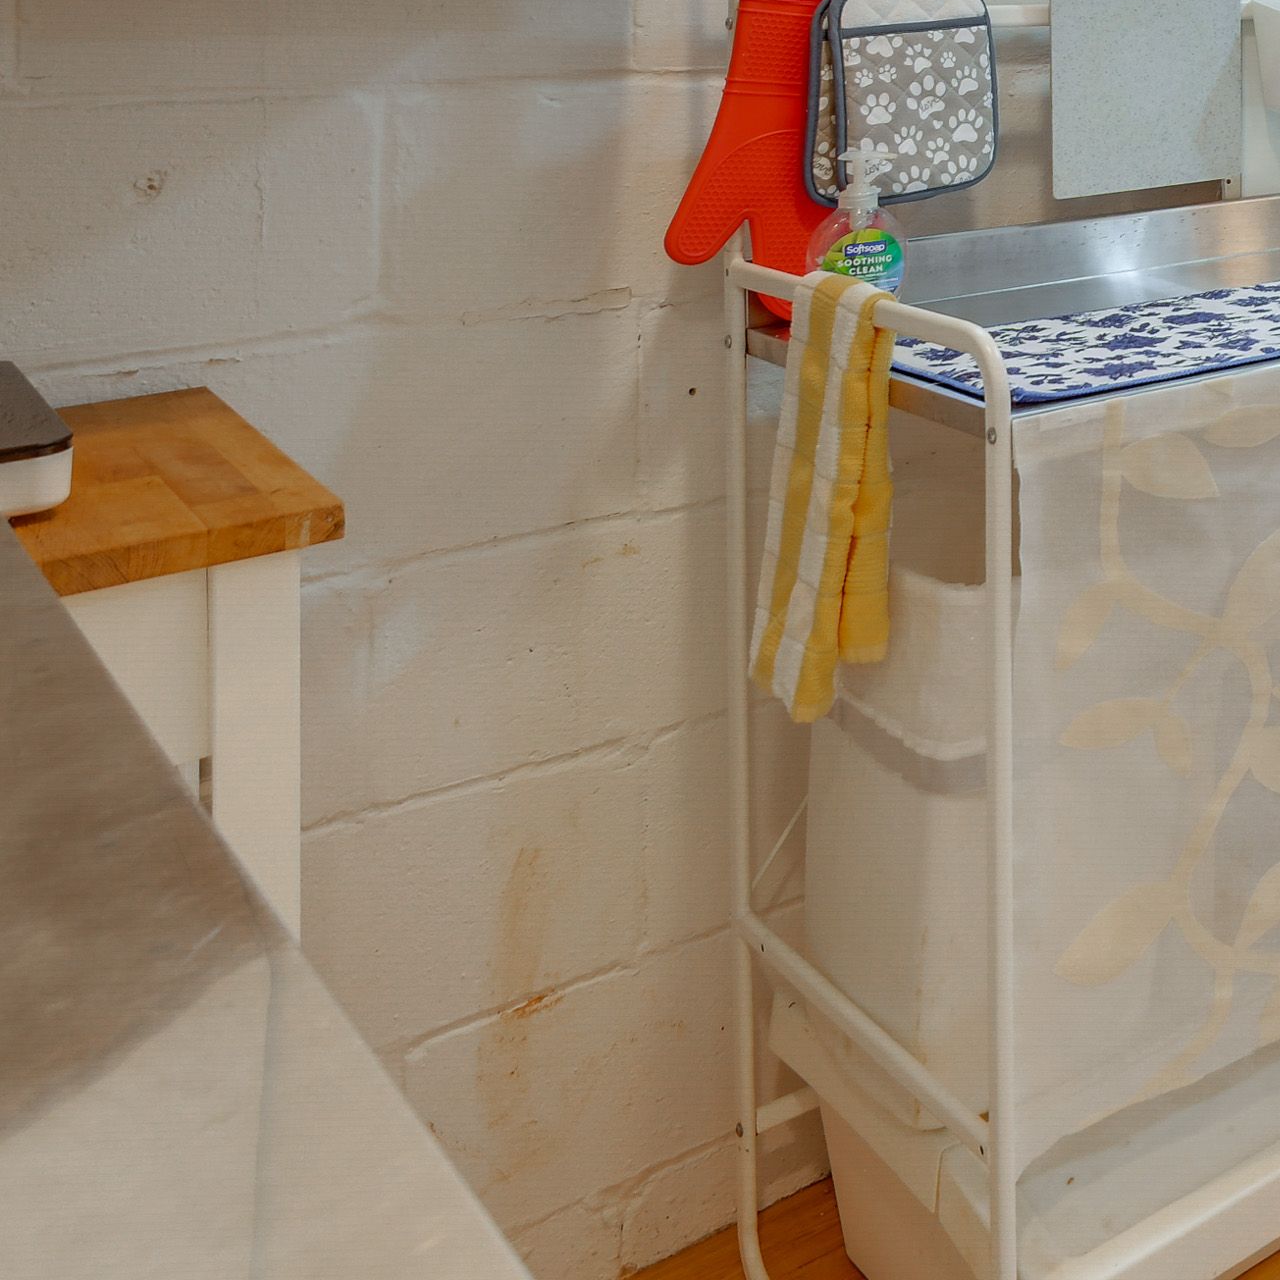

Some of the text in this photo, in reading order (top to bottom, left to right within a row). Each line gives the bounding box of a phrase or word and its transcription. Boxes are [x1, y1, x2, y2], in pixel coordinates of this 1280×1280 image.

[847, 244, 885, 254] Softsoap
[837, 254, 893, 268] SOOTHING
[849, 265, 883, 275] CLEAN
